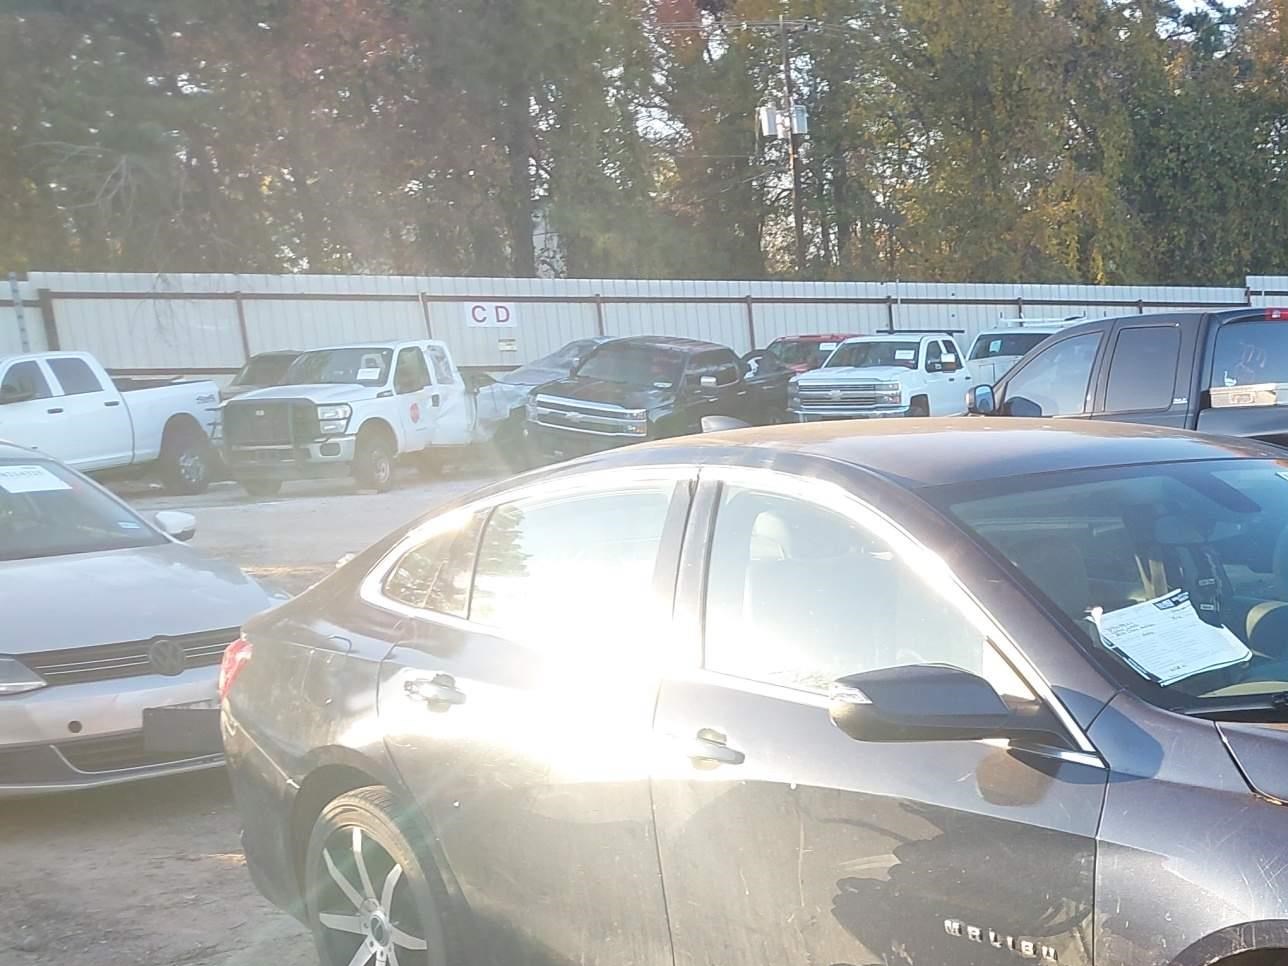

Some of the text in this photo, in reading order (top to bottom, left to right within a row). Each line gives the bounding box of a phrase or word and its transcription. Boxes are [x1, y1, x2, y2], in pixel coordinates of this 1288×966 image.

[471, 305, 511, 323] C D
[944, 919, 1058, 962] MALIBU
